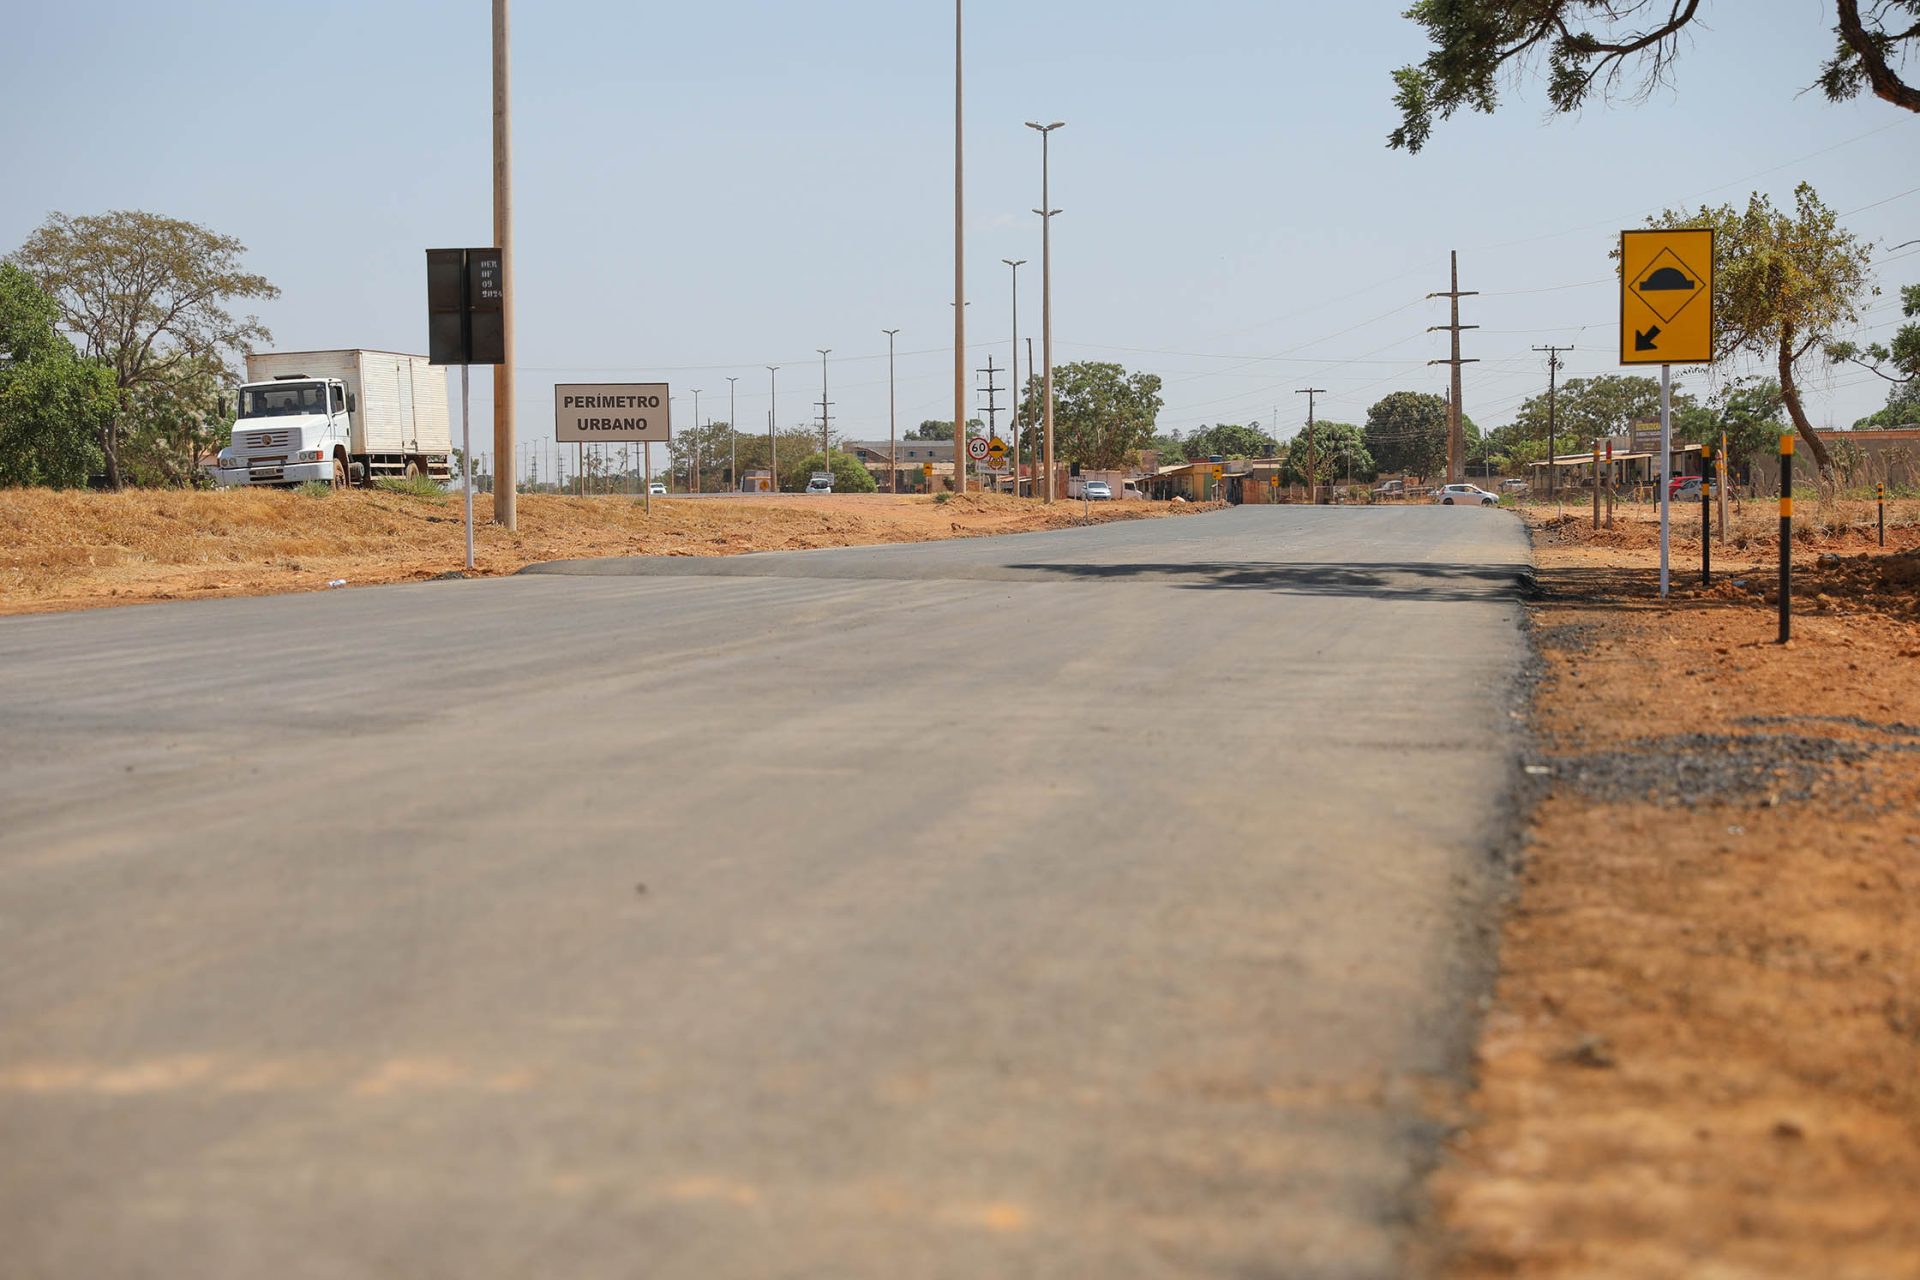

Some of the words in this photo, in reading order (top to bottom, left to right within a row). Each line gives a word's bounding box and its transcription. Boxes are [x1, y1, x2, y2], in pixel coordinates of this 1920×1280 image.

[564, 393, 660, 408] PERÍMETRO
[577, 418, 648, 431] URBANO
[972, 443, 985, 452] 60
